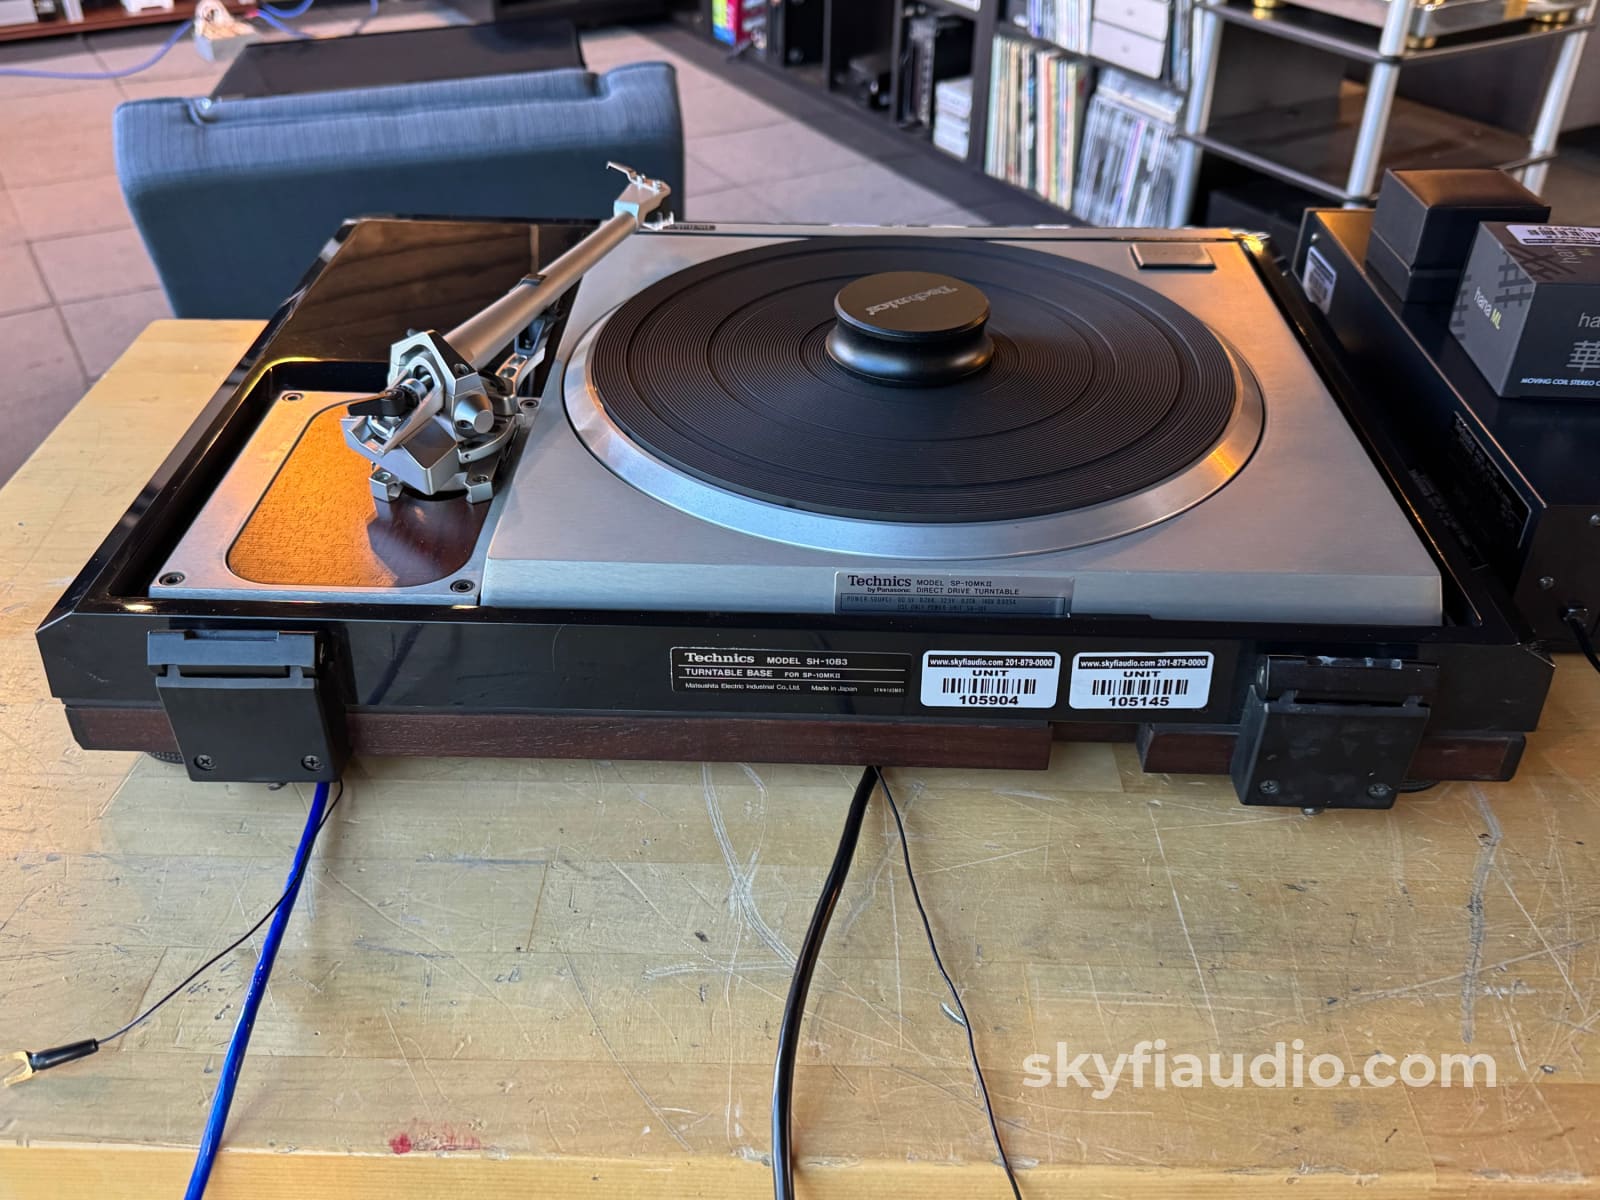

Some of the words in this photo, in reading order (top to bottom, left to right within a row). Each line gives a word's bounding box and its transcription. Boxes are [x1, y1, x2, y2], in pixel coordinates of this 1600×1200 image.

[1473, 286, 1492, 318] hana
[1490, 308, 1502, 330] ML
[1520, 377, 1552, 385] MOVING
[847, 574, 912, 587] Technics
[916, 579, 945, 587] MODEL
[684, 652, 755, 664] Technics
[766, 656, 801, 665] MODEL
[806, 657, 848, 666] SH-10B3
[929, 657, 1004, 668] www.skyfiaudio.com
[1005, 657, 1053, 667] 201-879-0000
[1080, 659, 1155, 669] www.skyfiaudio.com
[1157, 658, 1206, 667] 201-879-0000
[684, 667, 743, 677] TURNTABLE
[746, 669, 773, 677] BASE
[685, 681, 719, 689] Matsushita
[721, 682, 744, 690] Electric
[838, 685, 858, 693] Japan
[959, 695, 1018, 705] 105904
[1108, 696, 1170, 707] 105145
